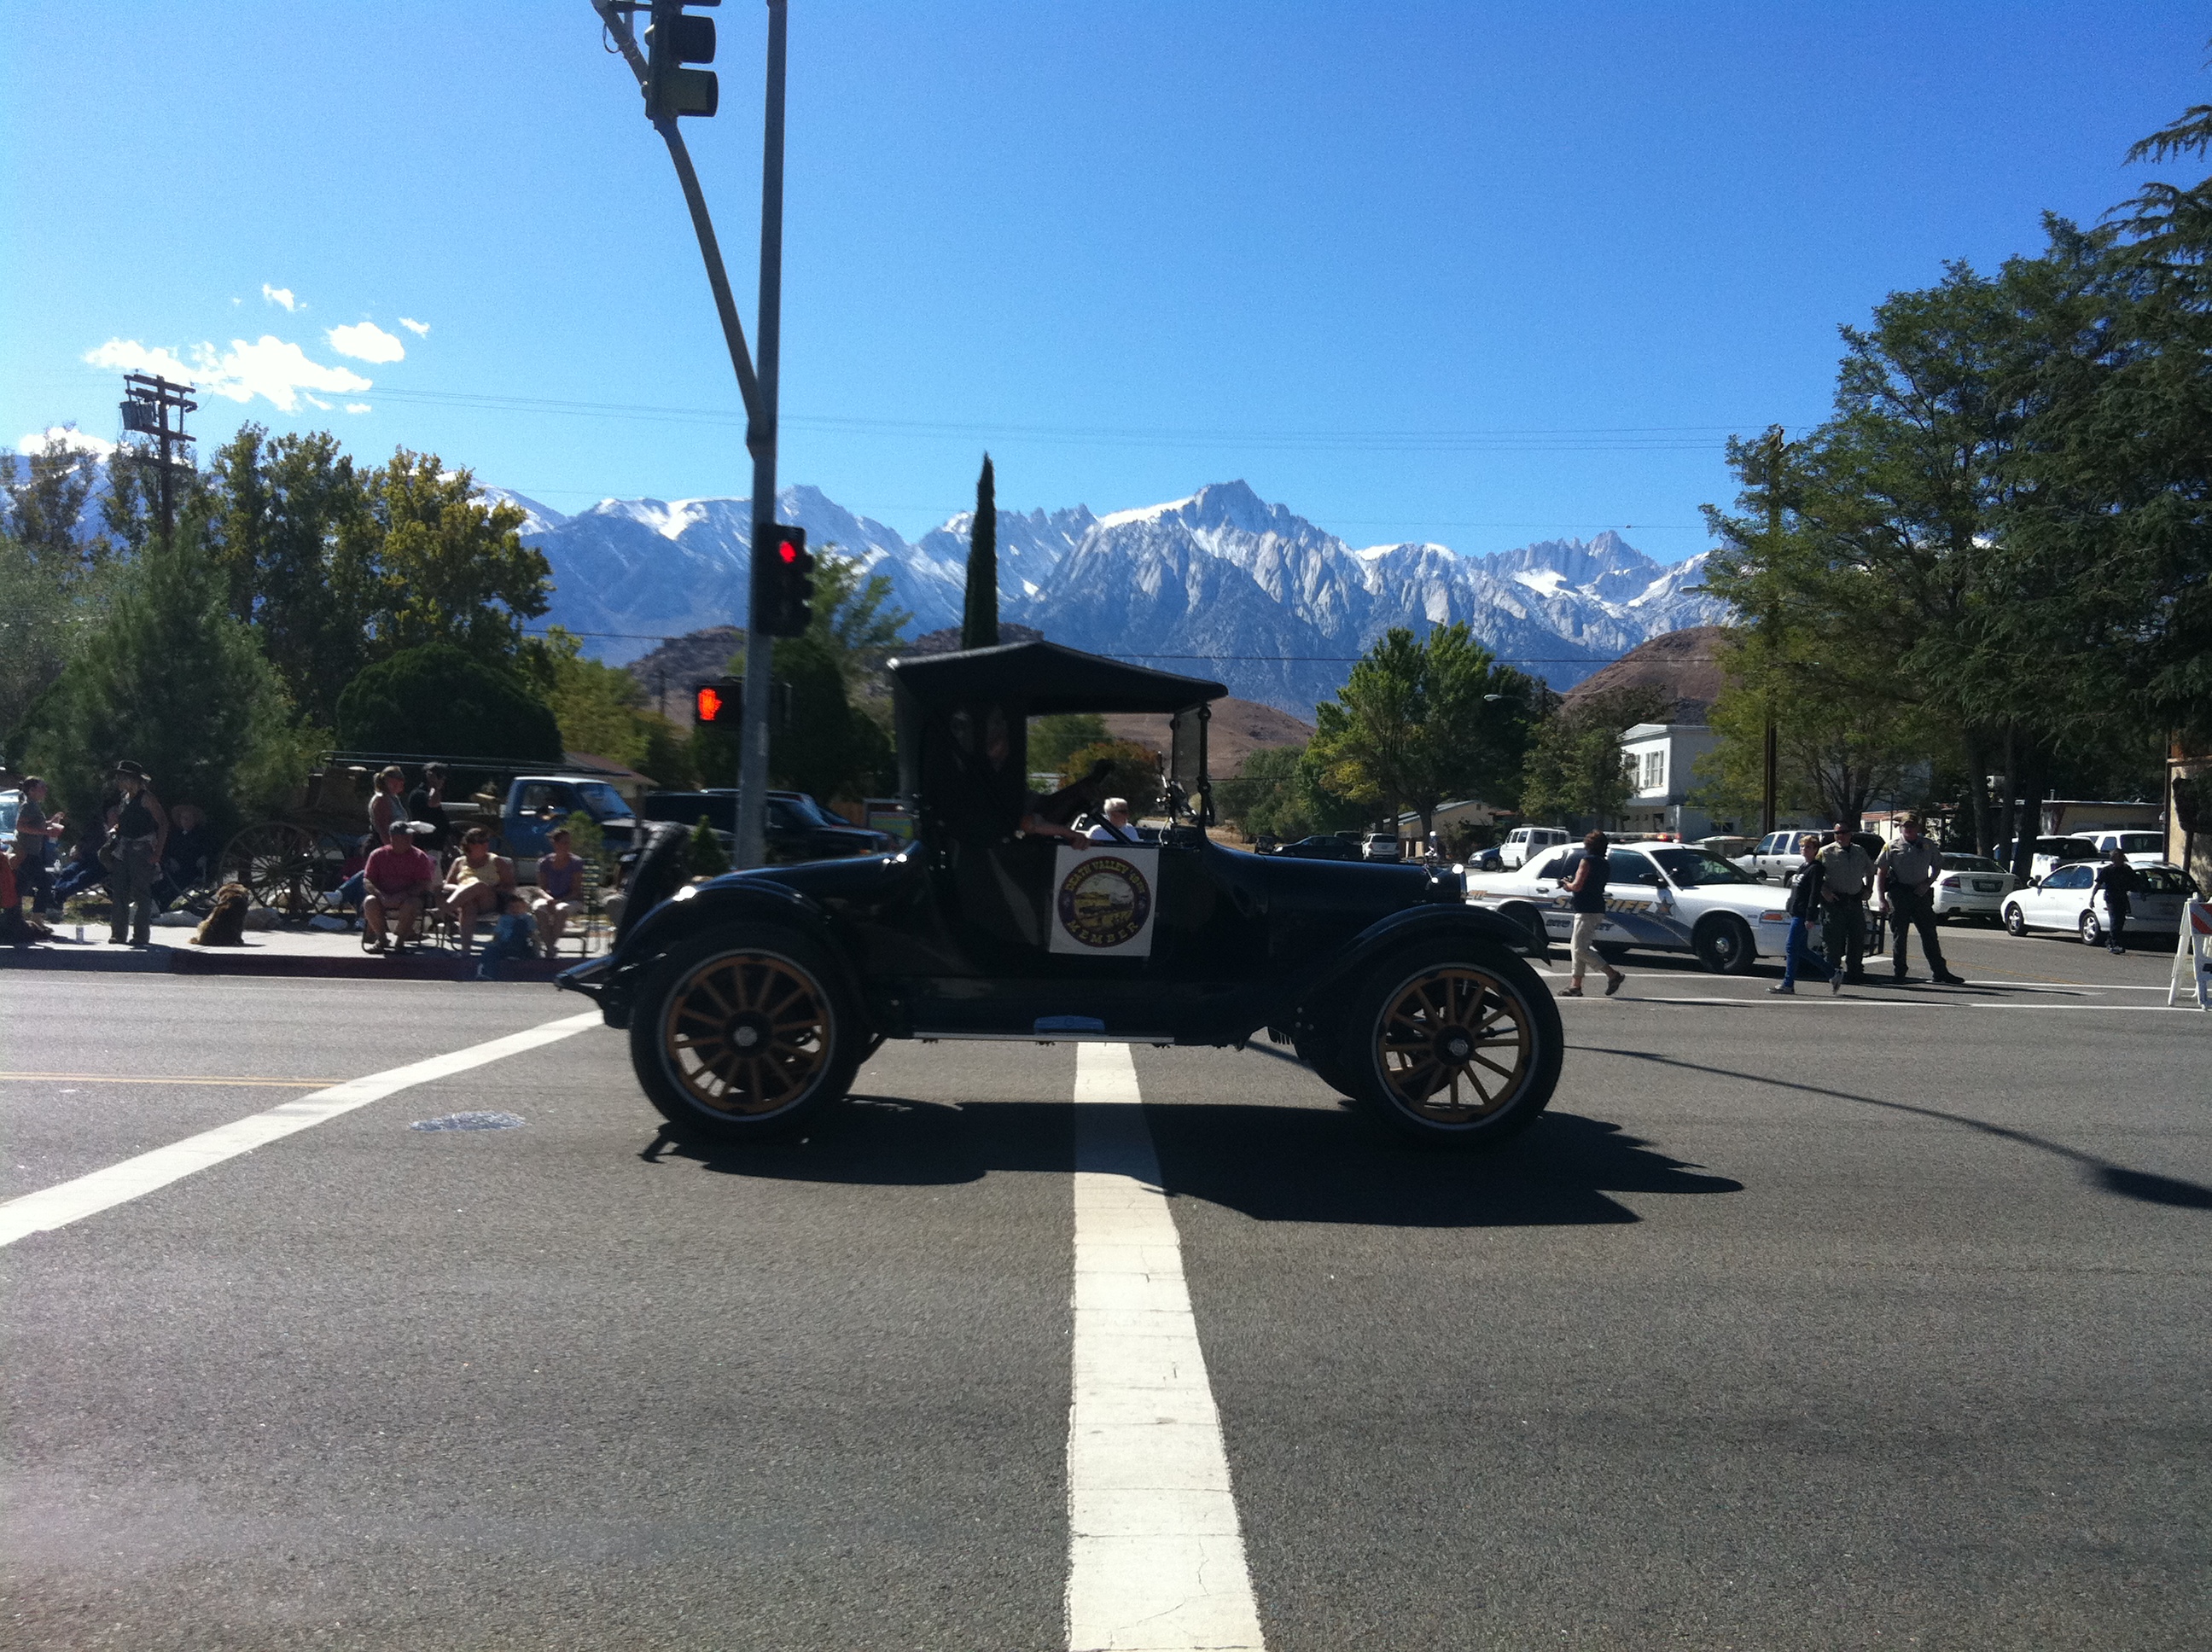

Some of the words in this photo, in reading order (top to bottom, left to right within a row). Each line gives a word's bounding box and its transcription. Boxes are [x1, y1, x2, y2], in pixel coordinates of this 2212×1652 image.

[1065, 864, 1092, 891] DEATH
[1092, 860, 1129, 874] VALLEY
[1551, 895, 1653, 915] SRIFF
[1067, 920, 1138, 944] MEMBER
